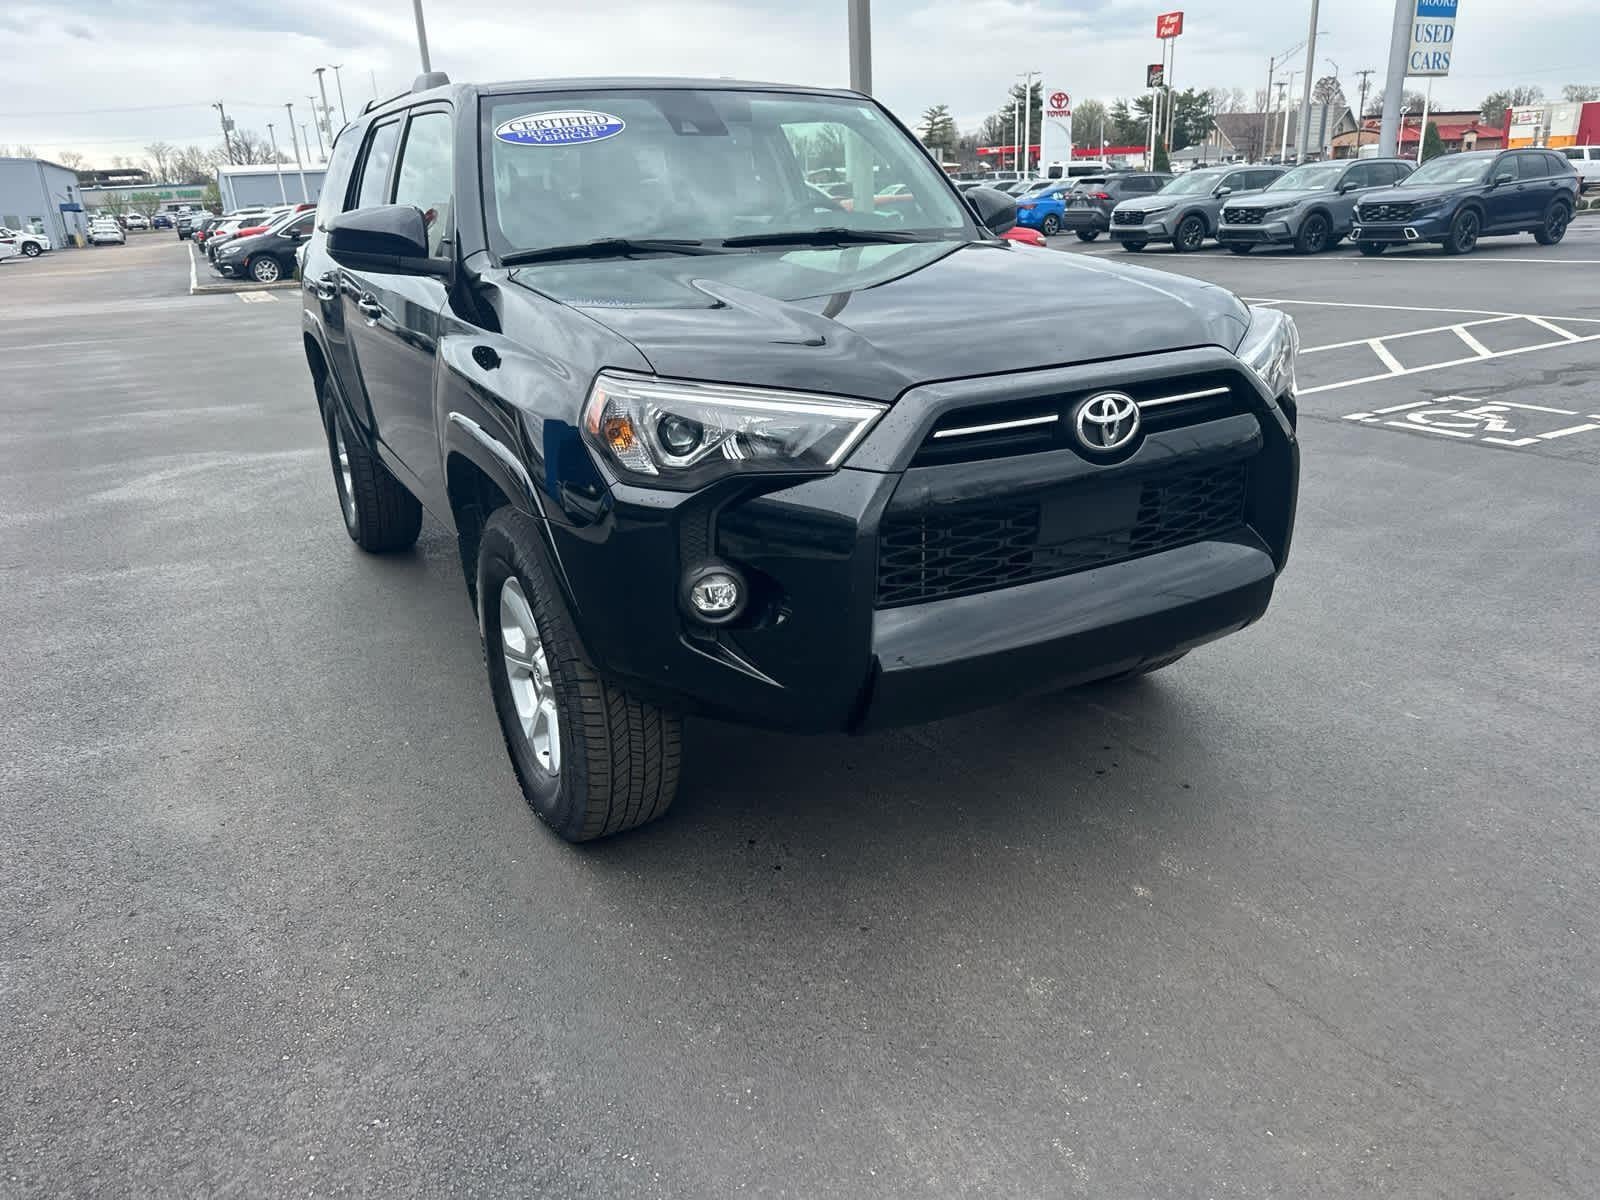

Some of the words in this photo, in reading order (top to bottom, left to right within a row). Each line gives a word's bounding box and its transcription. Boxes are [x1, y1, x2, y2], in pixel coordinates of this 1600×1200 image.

[1415, 23, 1454, 43] USED
[1411, 51, 1450, 70] CARS
[1047, 110, 1071, 118] TOYOTA
[508, 115, 609, 132] CERTIFIED
[517, 125, 608, 139] PRE-OWNED
[532, 131, 599, 142] VEHICLE
